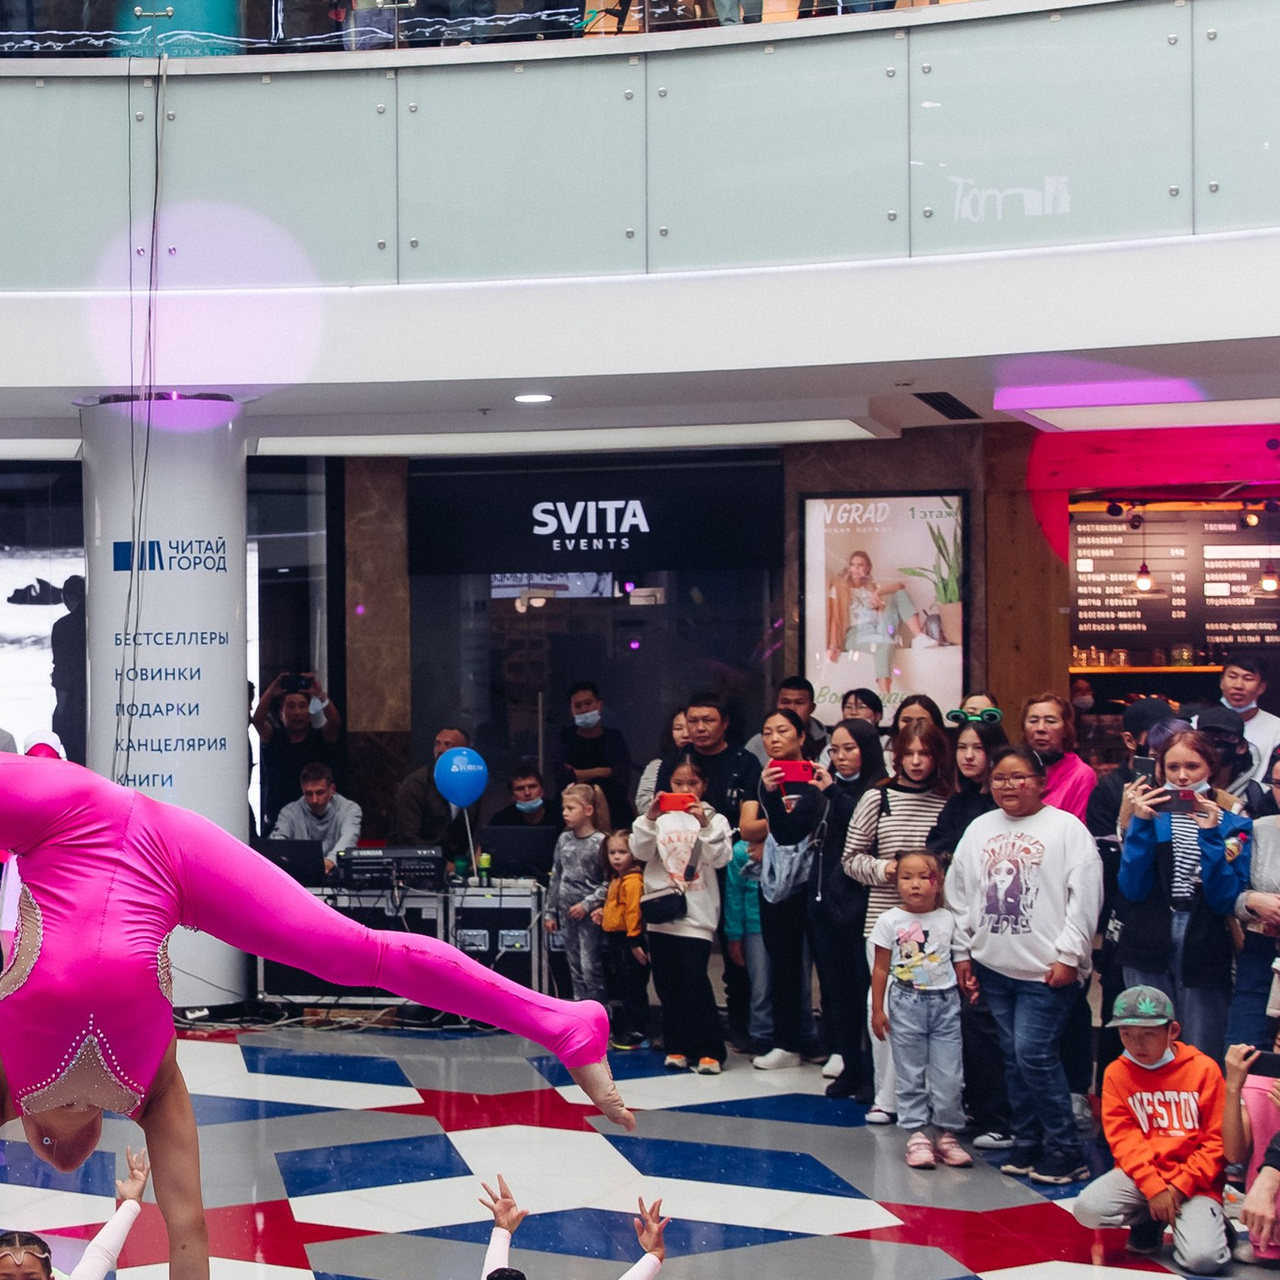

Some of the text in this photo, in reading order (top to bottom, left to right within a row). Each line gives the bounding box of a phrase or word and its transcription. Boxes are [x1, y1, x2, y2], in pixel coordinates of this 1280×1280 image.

[532, 500, 650, 535] SVITA
[837, 502, 890, 524] GRAD
[908, 507, 916, 519] 1
[169, 536, 226, 555] ЧИТАЙ
[552, 538, 630, 551] EVENTS
[169, 556, 227, 573] ГОРОД
[114, 631, 229, 646] БЕСТСЕЛЛЕРЫ
[115, 668, 201, 681] НОВИНКИ
[115, 703, 200, 718] ПОДАРКИ
[115, 737, 227, 754] КАНЦЕЛЯРИЯ
[116, 773, 173, 788] КНИГИ
[1127, 1091, 1200, 1134] WESTON
